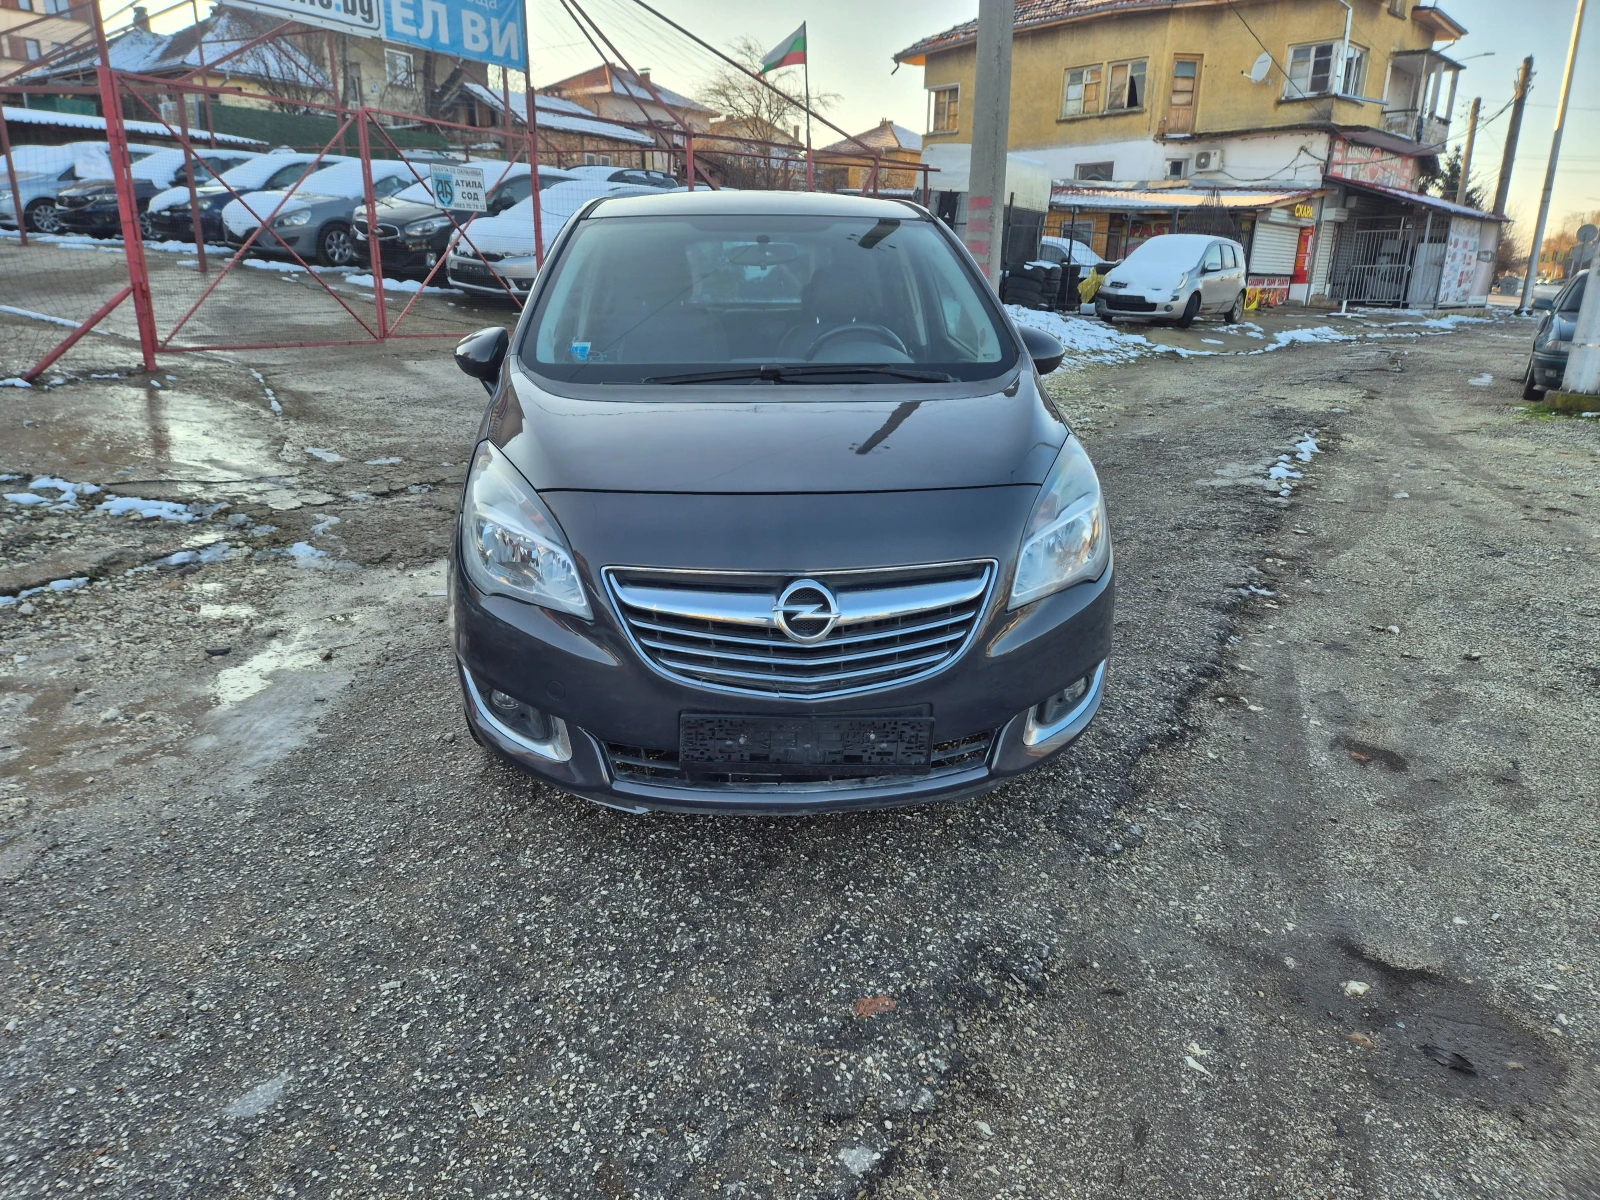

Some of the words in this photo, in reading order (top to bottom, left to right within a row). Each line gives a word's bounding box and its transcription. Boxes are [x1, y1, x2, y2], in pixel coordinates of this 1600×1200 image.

[390, 0, 450, 45] ЕЛ
[461, 9, 520, 60] ВИ
[455, 179, 483, 189] АТИЛА
[461, 191, 480, 202] СОД
[1131, 222, 1173, 238] FAST
